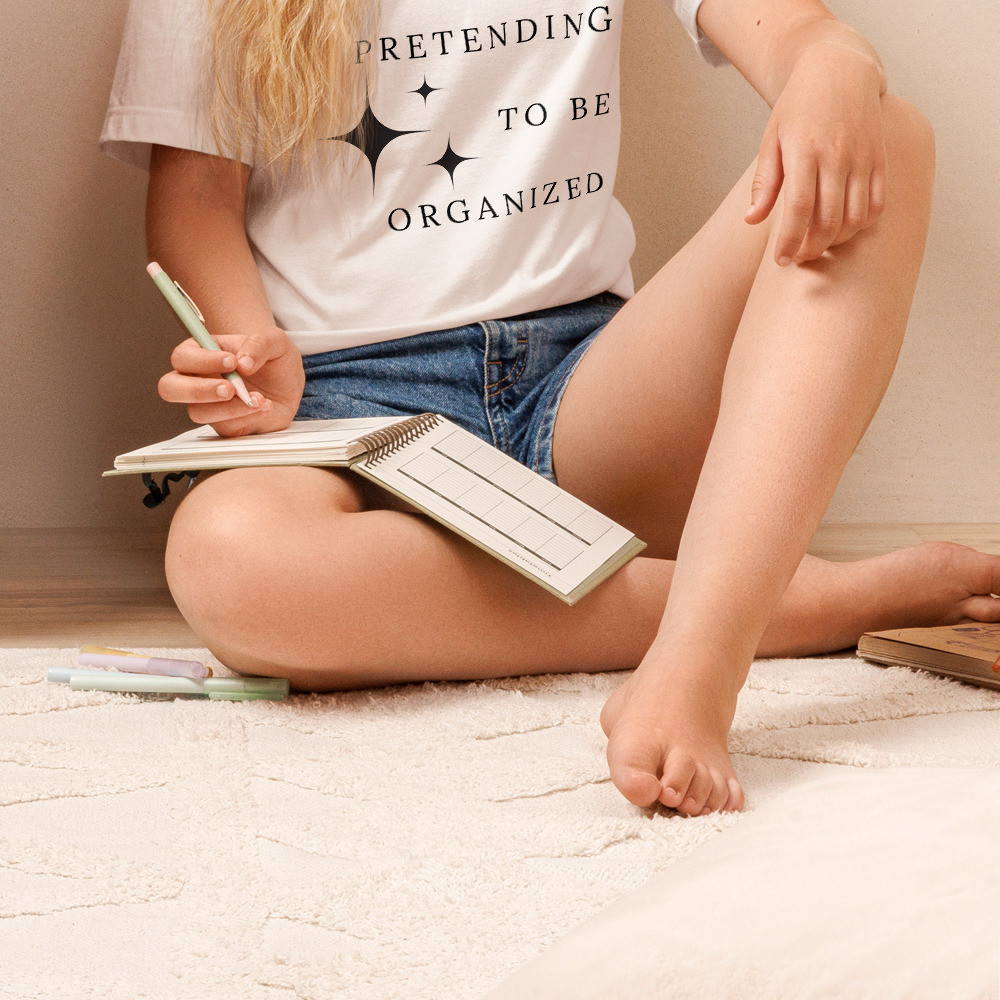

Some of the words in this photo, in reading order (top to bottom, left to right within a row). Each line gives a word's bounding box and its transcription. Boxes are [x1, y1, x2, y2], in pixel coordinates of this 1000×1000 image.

[354, 5, 613, 65] PRETENDING
[497, 102, 548, 131] TO
[569, 92, 611, 121] BE
[387, 171, 604, 232] ORGANIZED
